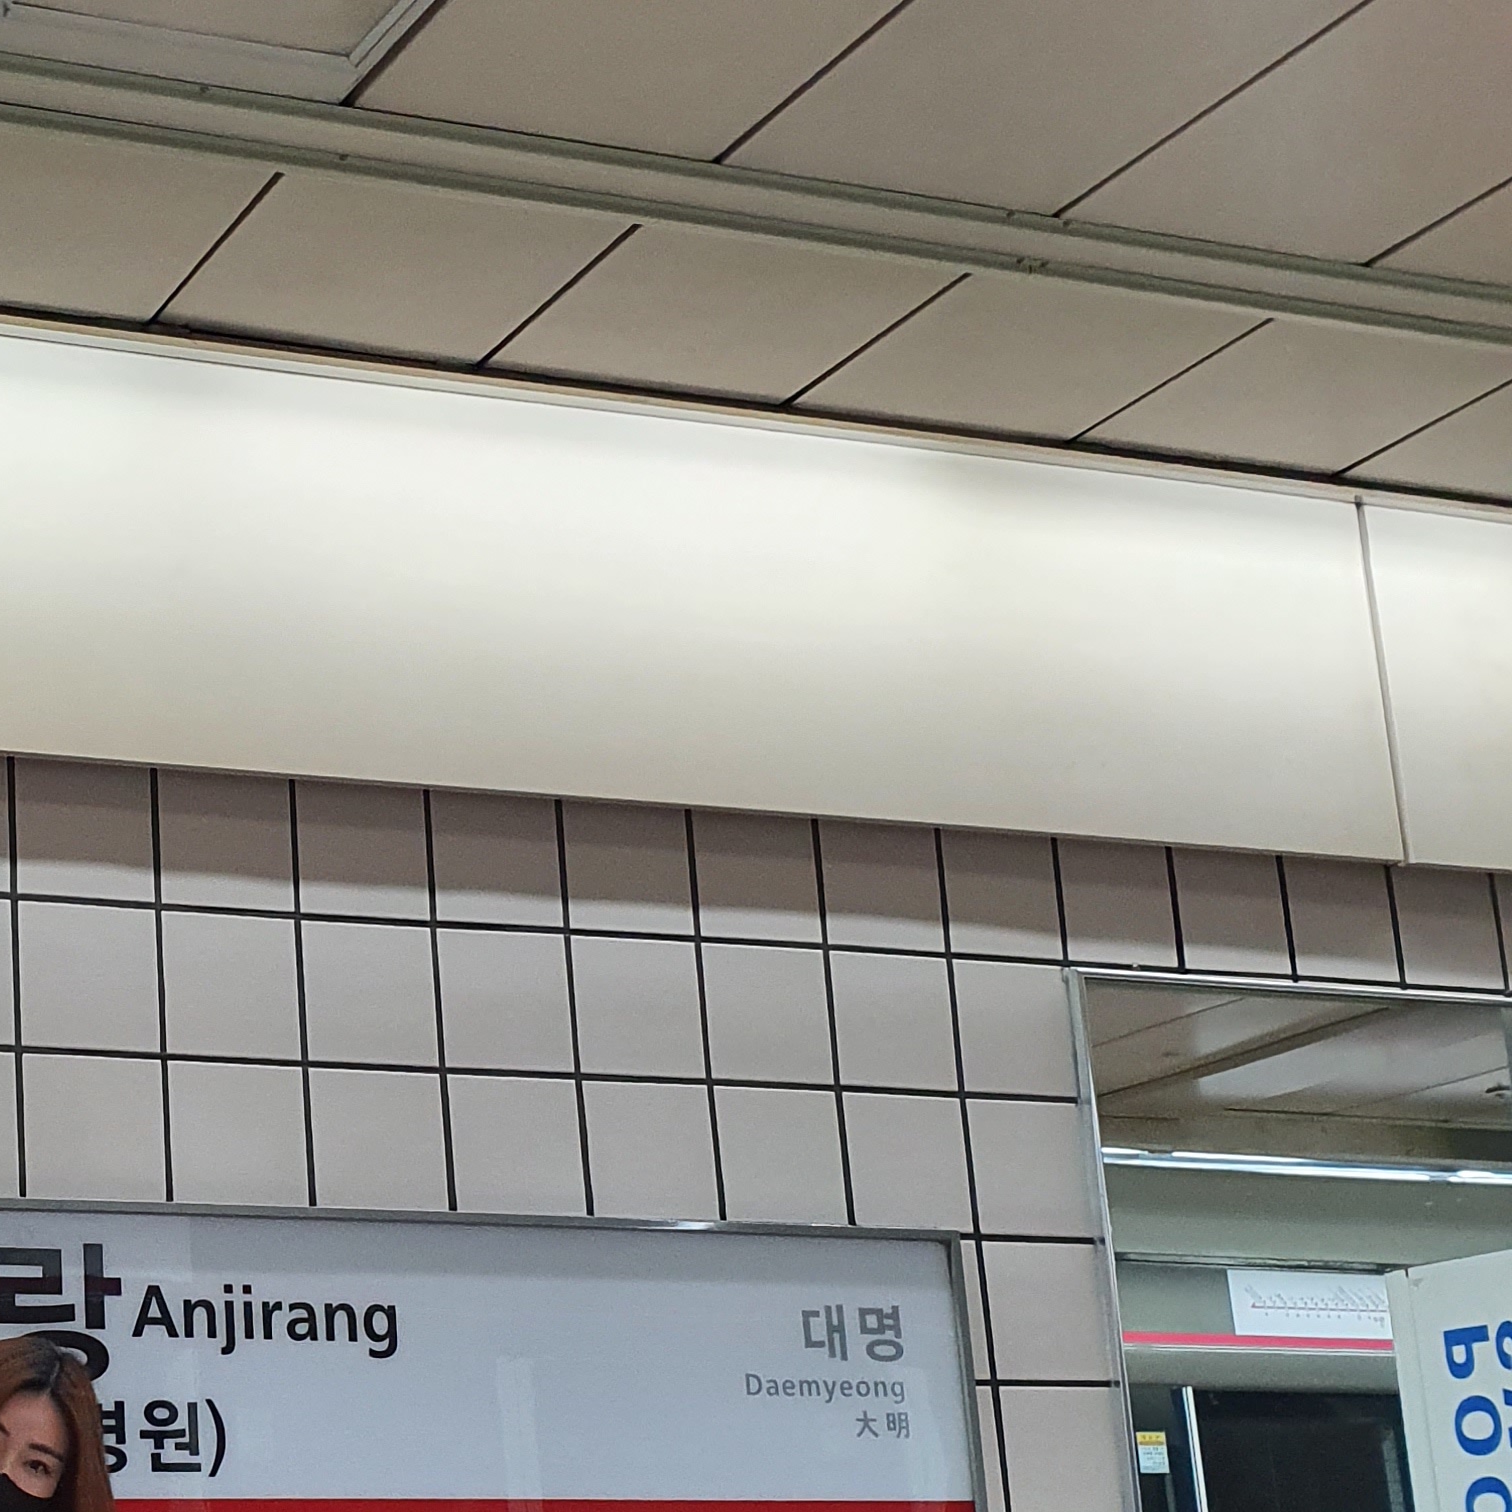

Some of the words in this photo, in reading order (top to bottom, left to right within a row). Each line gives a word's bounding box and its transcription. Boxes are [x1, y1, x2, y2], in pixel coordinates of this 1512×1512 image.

[132, 1283, 399, 1359] Anjirang
[801, 1304, 904, 1363] 대명
[744, 1373, 906, 1405] Daemyeong
[855, 1410, 911, 1439] 大明
